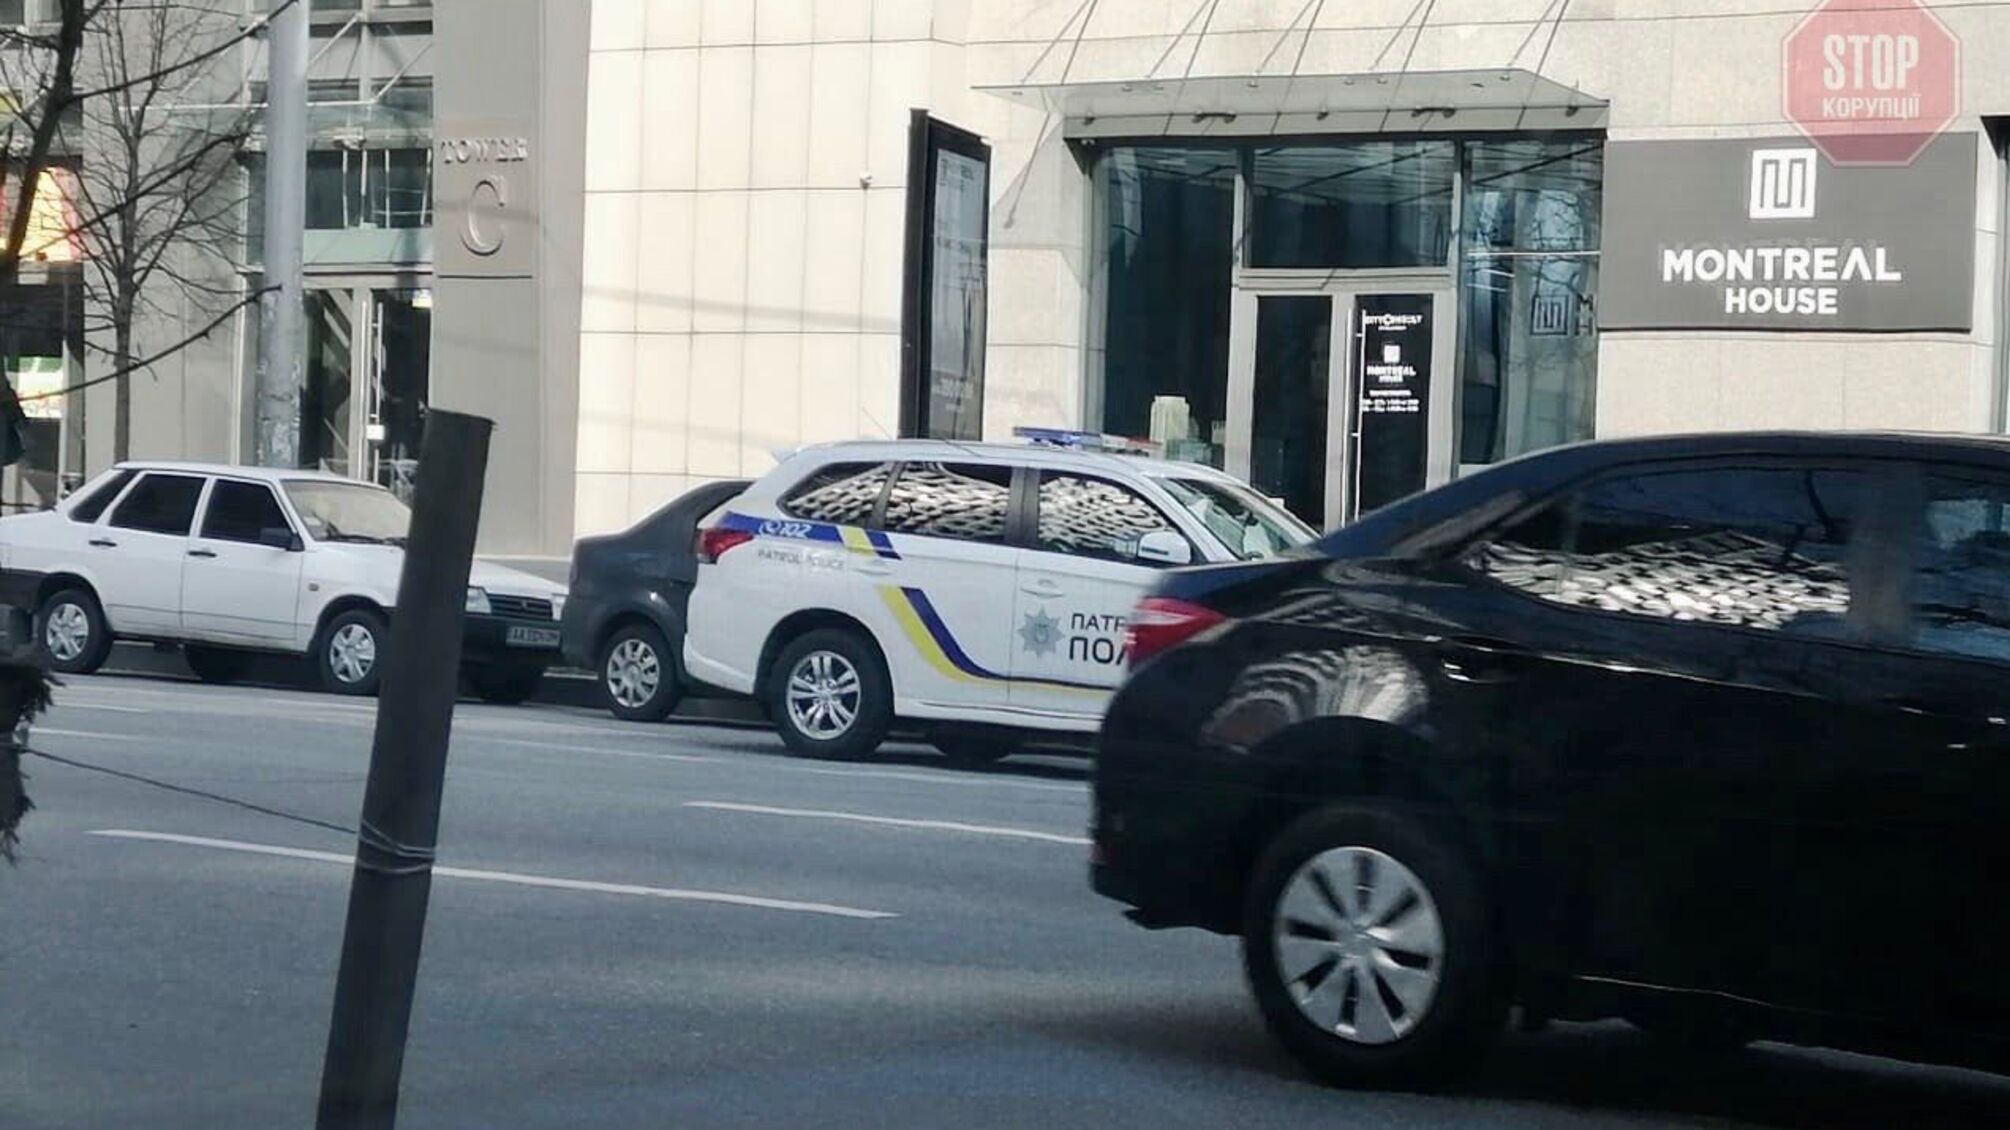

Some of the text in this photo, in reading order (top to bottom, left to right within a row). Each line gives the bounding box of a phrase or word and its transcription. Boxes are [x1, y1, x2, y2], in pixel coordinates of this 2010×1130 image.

[440, 137, 528, 164] TOWER
[458, 175, 507, 257] C
[1662, 247, 1902, 282] MONTREAL
[1724, 286, 1838, 316] HOUSE
[780, 522, 813, 539] 102
[757, 548, 801, 565] PATROL
